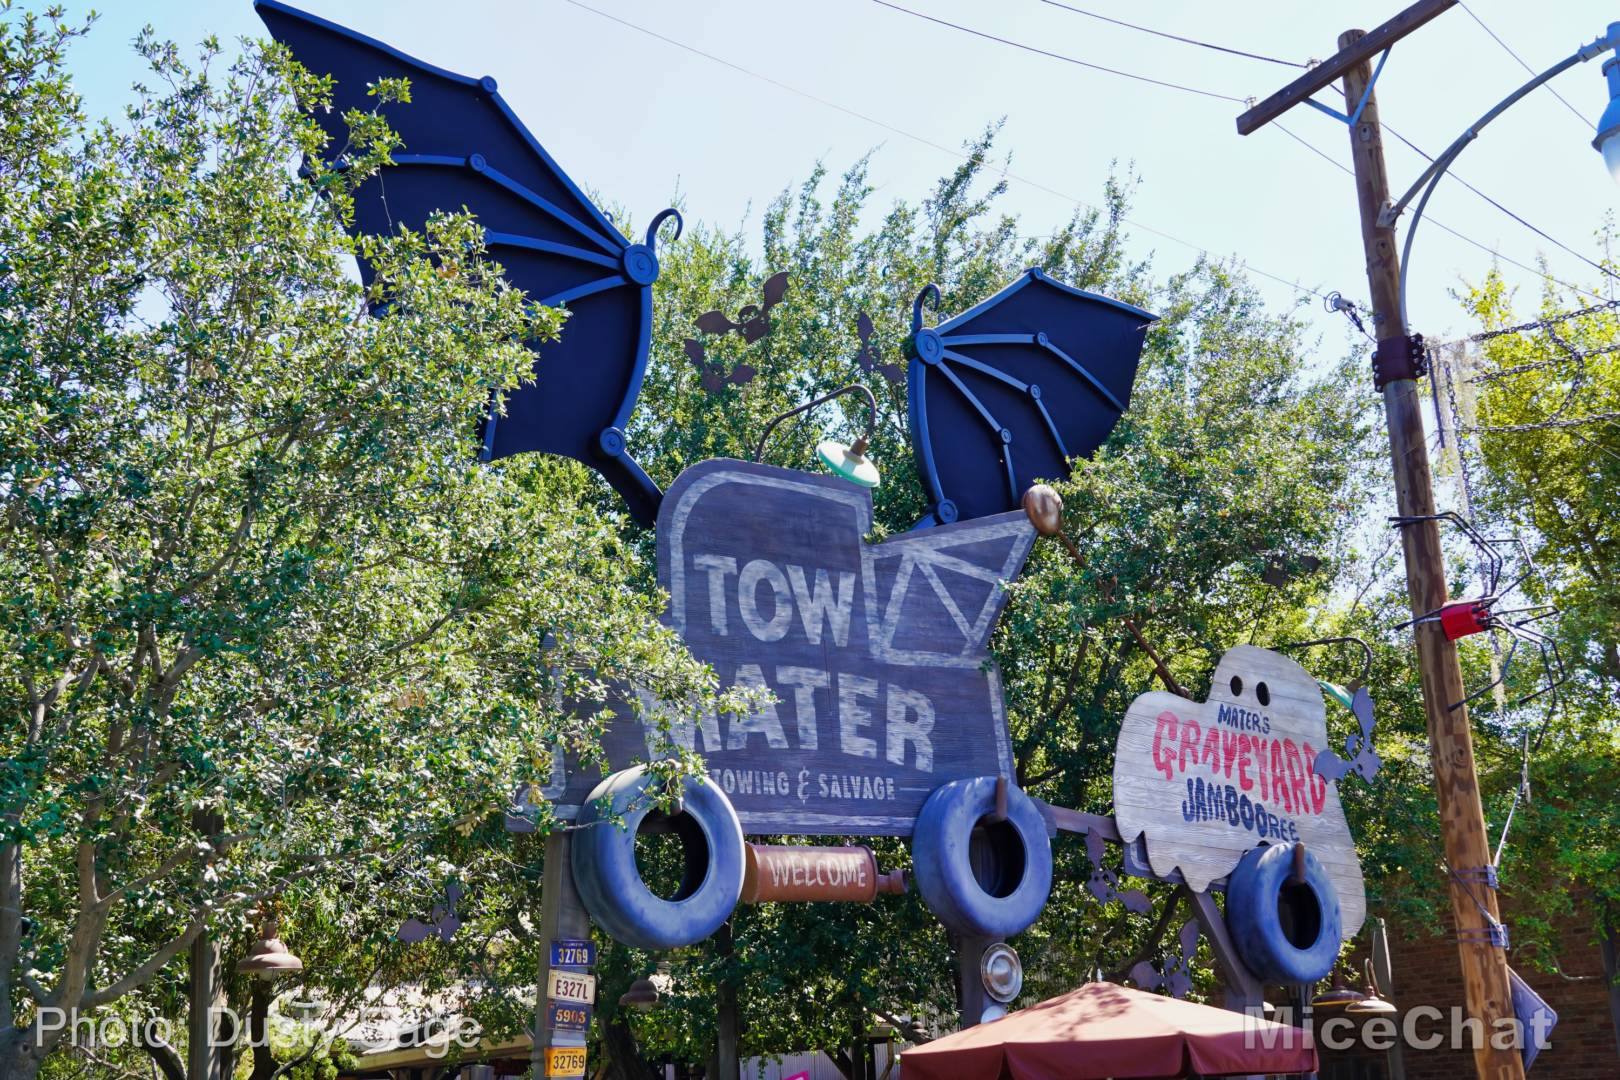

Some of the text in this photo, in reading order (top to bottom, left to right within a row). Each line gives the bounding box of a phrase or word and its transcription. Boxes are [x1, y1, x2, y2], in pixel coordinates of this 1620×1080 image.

[694, 554, 857, 648] TOW
[635, 664, 936, 774] MATER
[1218, 703, 1271, 735] MATER'S
[1152, 711, 1326, 816] GRAVEYARD
[712, 766, 896, 804] TOWING & SALVAGE
[1182, 776, 1299, 842] JAMBOOREE
[767, 855, 867, 888] WELCOME
[558, 948, 588, 964] 32769
[555, 979, 588, 1000] E327L
[553, 1055, 585, 1070] 32769
